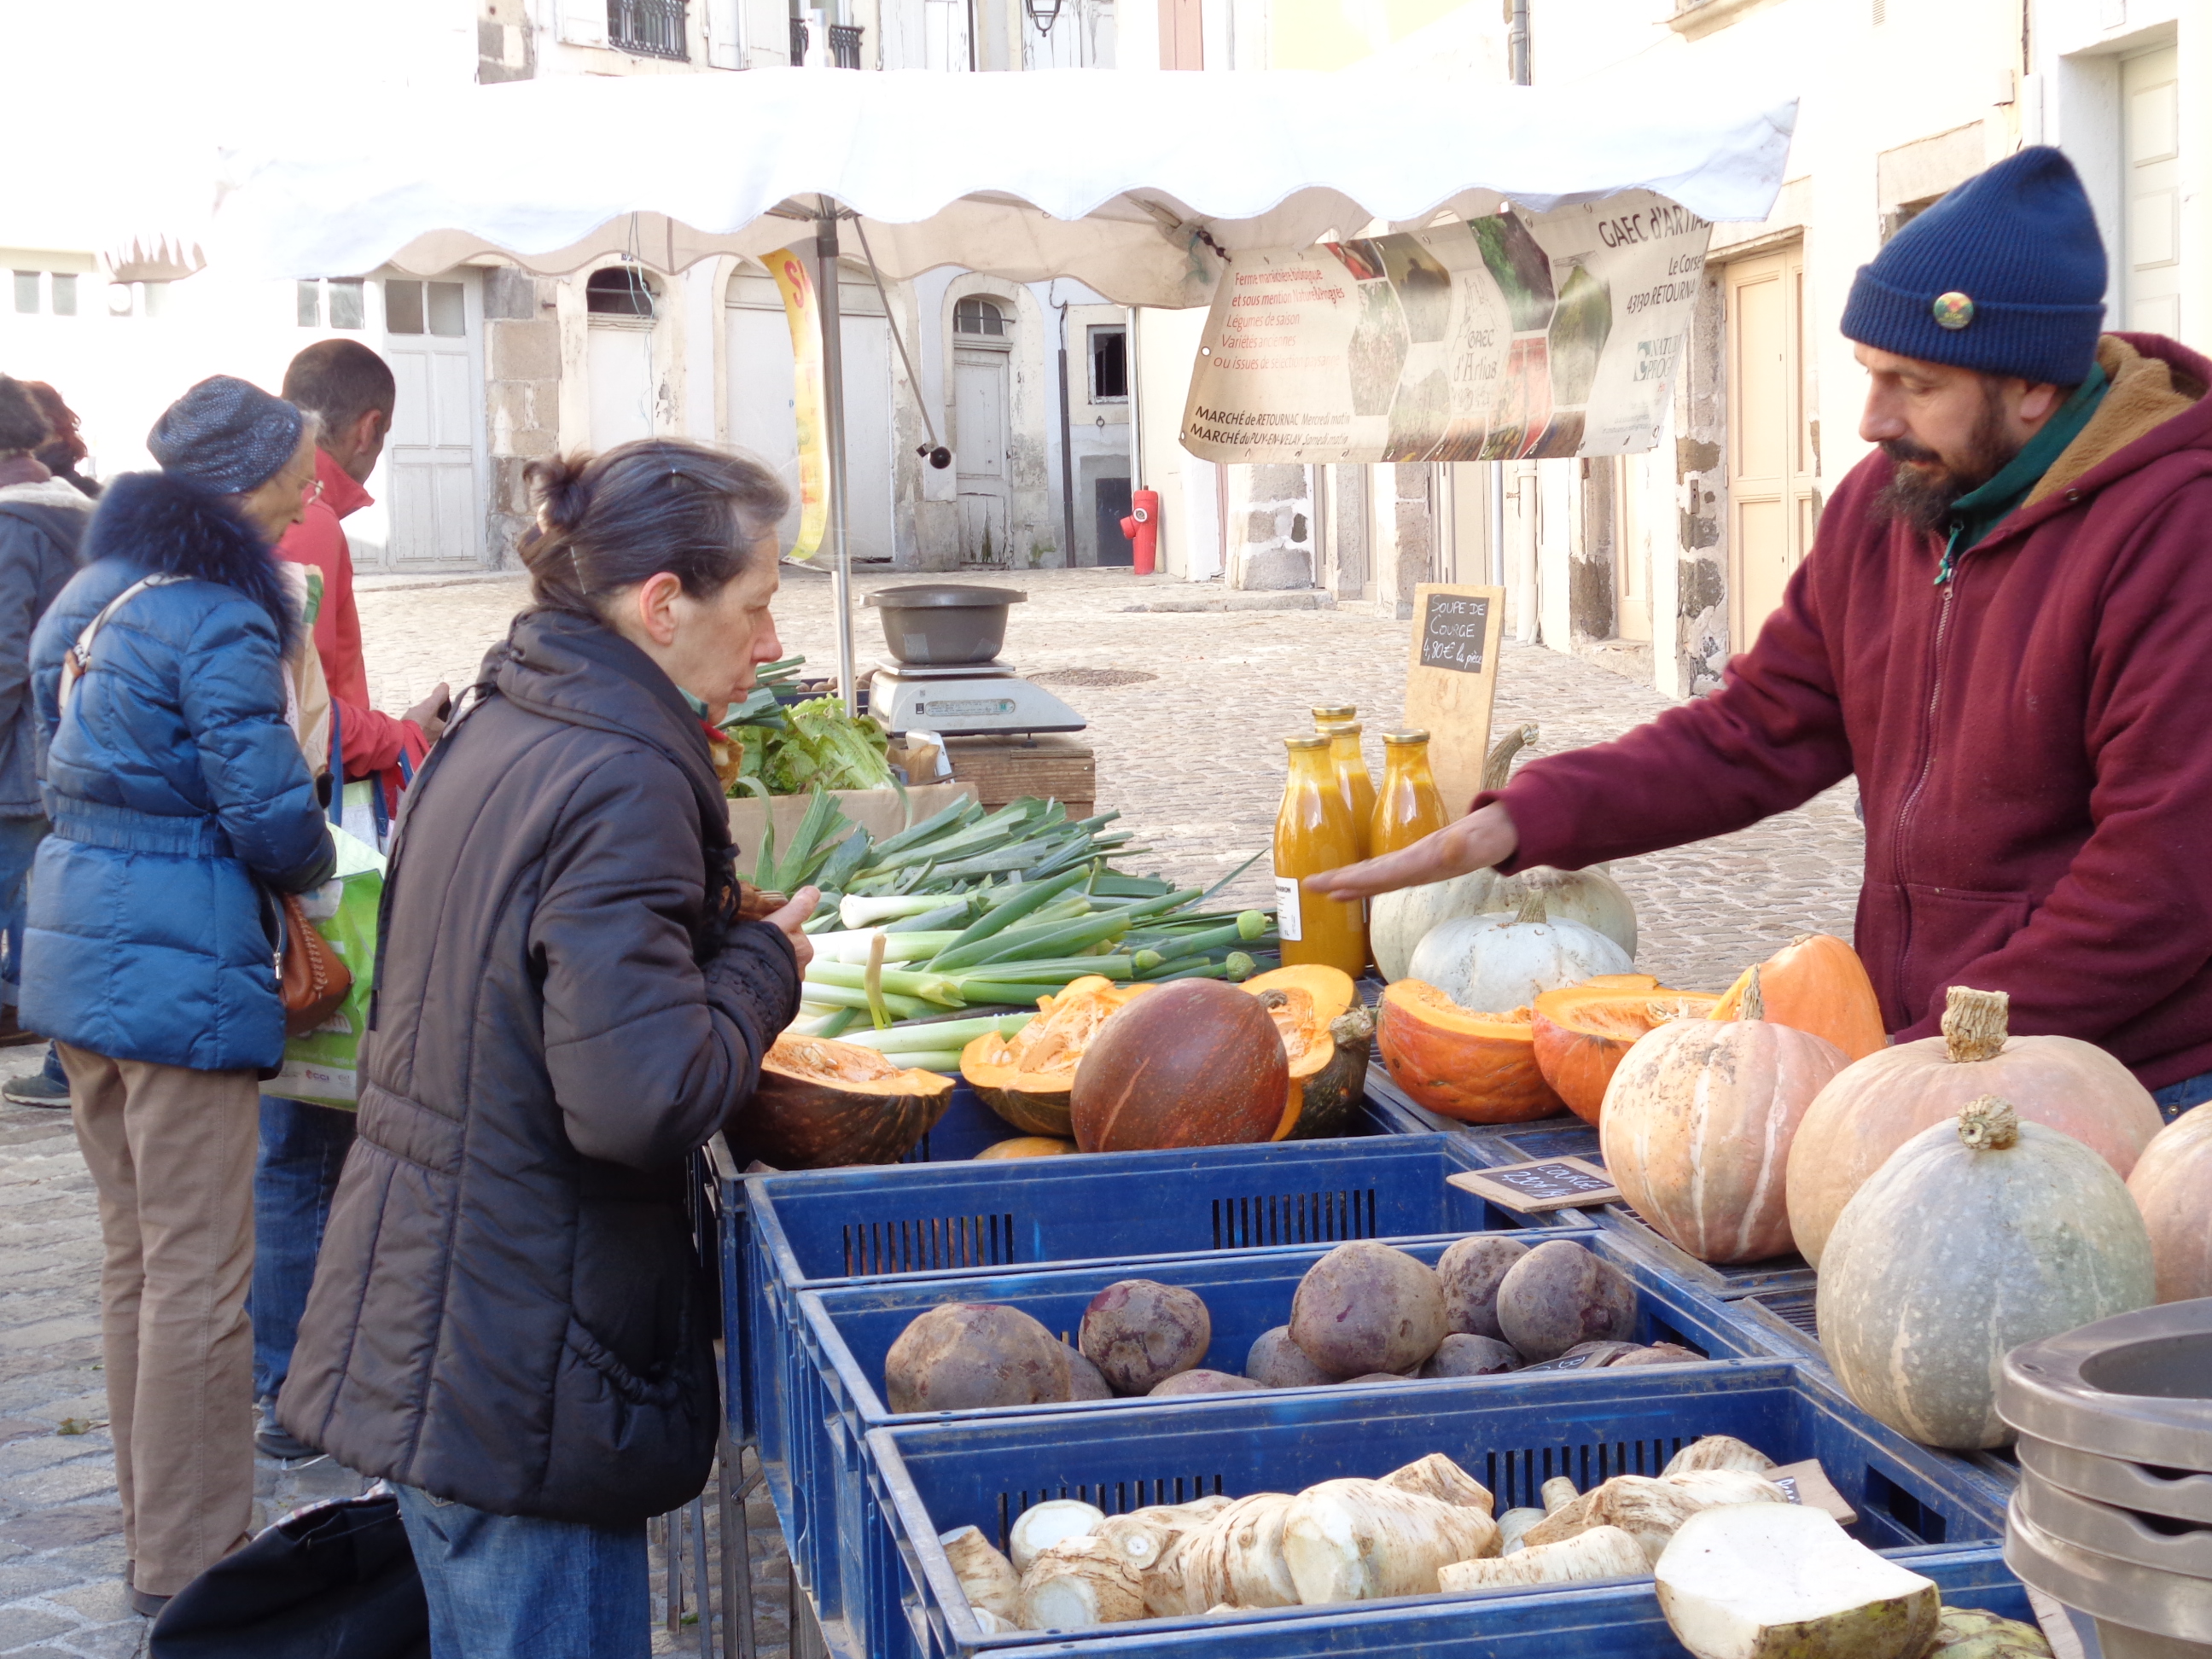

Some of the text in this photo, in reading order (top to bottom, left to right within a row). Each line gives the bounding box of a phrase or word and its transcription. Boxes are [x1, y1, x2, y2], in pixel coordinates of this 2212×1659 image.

[1598, 213, 1649, 248] GAEC
[1668, 253, 1703, 276] Le Corse
[1235, 267, 1324, 286] Ferme maraîchère biologique
[1231, 294, 1241, 307] et
[1242, 294, 1260, 307] sous
[1261, 292, 1291, 306] mention
[1627, 292, 1650, 314] 43130
[1226, 311, 1301, 333] Légumes de saison
[1222, 334, 1296, 348] Variétés anciennes
[1468, 329, 1494, 349] GAEC
[1214, 353, 1341, 370] ou issues de sélection paysanne
[1195, 405, 1350, 426] MARCHÉ de RETOURNAC Mercredi matin
[1190, 423, 1348, 445] MARCHÉ du PUY-EN-VELAY Samedi matin
[1431, 595, 1486, 615] SOUPE DE
[1430, 614, 1476, 637] COURGE
[1423, 637, 1482, 669] 4,80€ la pièce
[1537, 1165, 1608, 1190] COURGE
